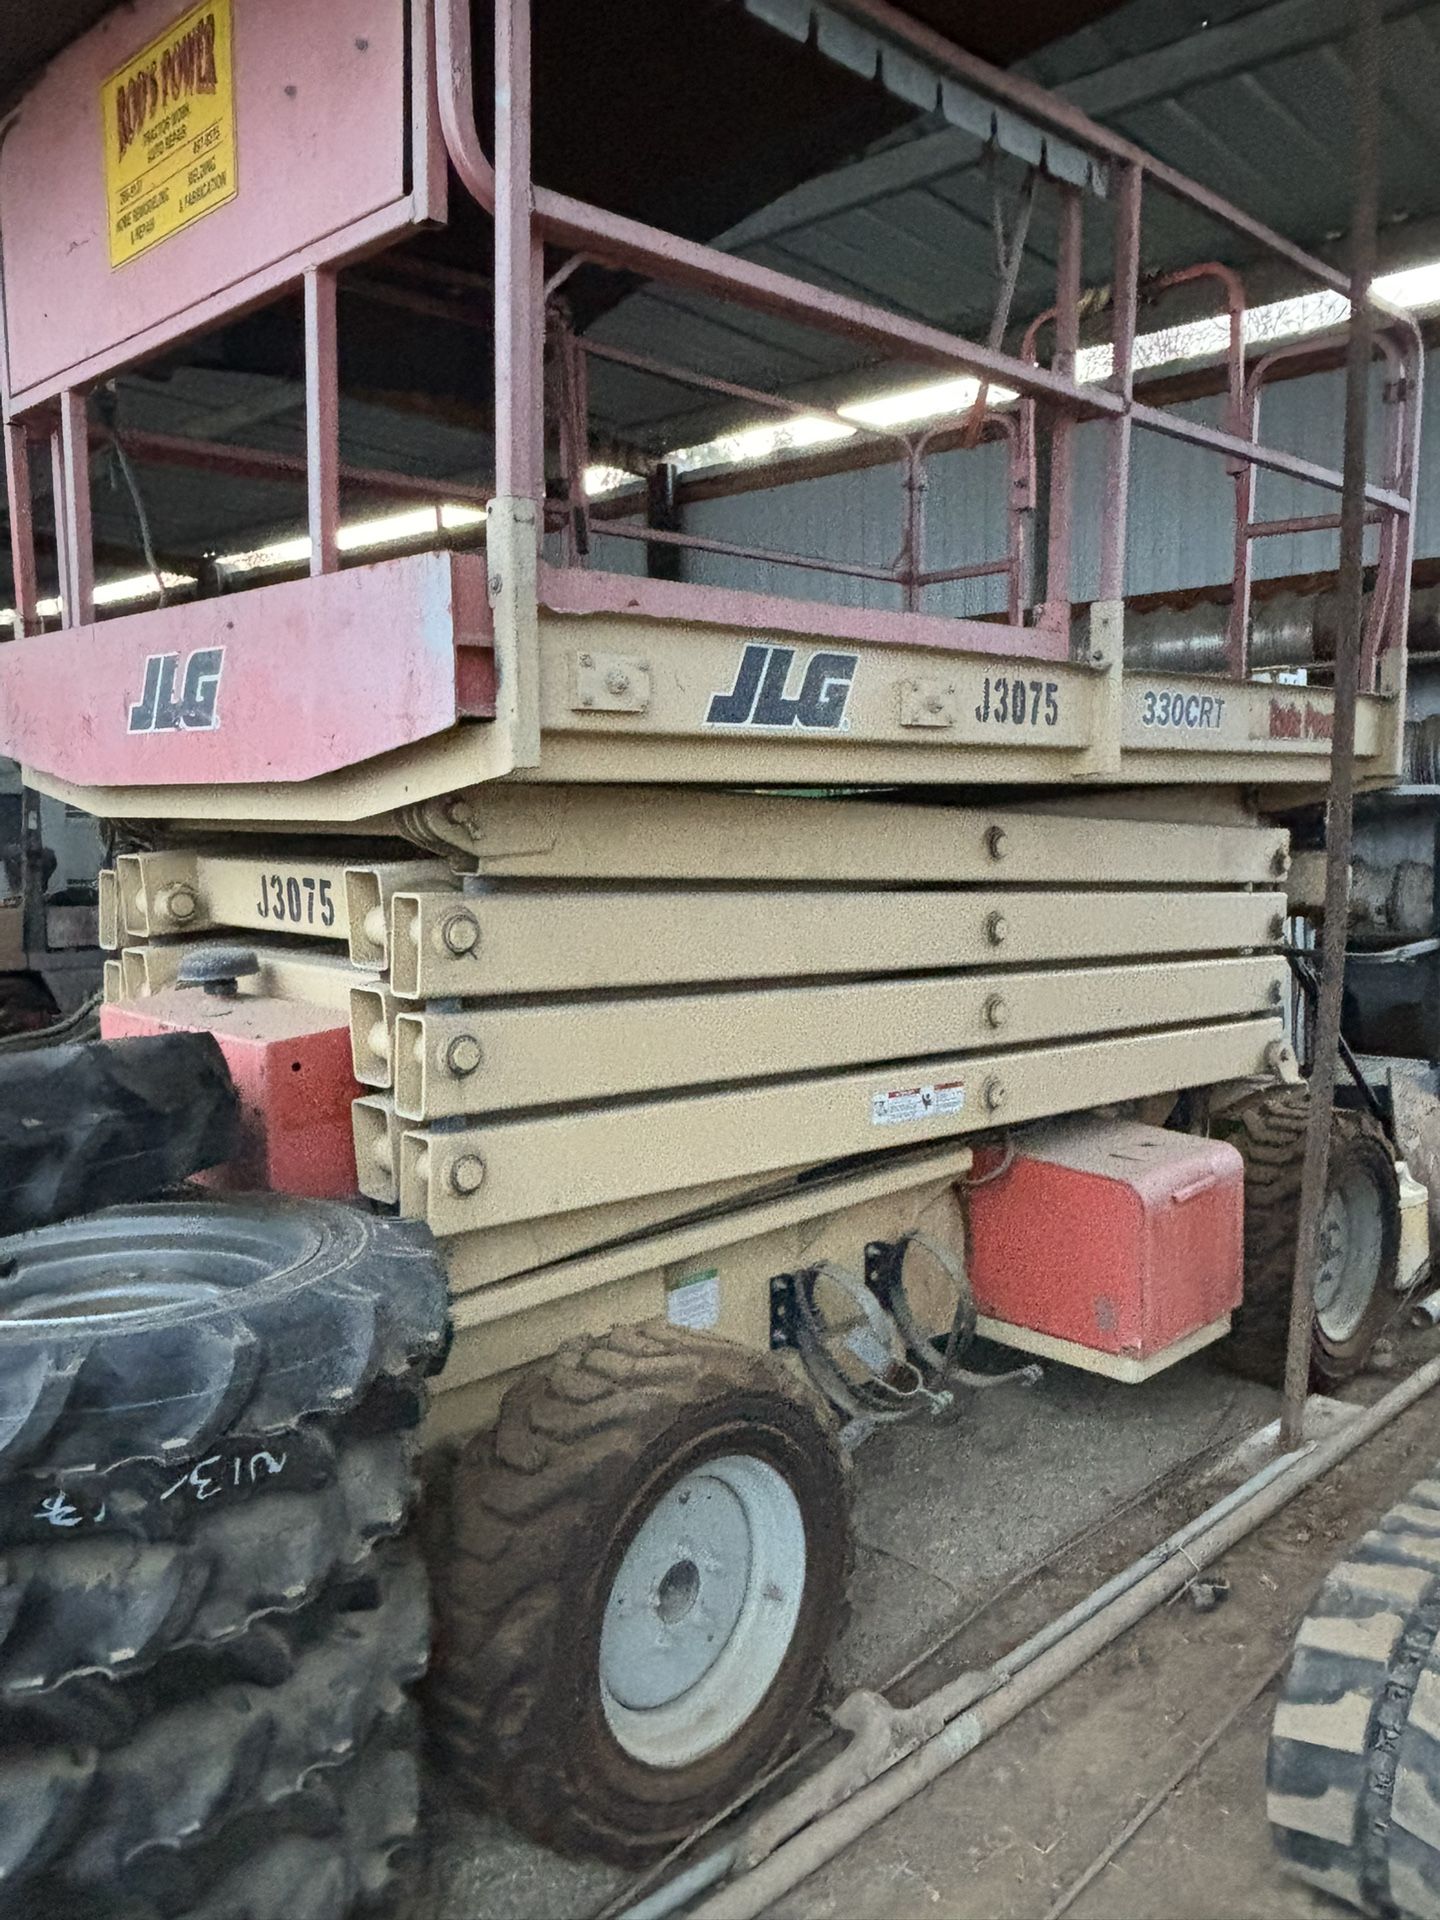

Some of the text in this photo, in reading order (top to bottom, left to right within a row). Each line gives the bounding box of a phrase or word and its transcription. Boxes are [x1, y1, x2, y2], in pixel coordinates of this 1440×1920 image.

[184, 170, 227, 208] FABRICATION
[127, 645, 226, 734] JLG
[703, 643, 861, 731] JLG
[974, 677, 1058, 726] J3075
[1142, 690, 1226, 729] 330CRT
[256, 874, 335, 926] J3075
